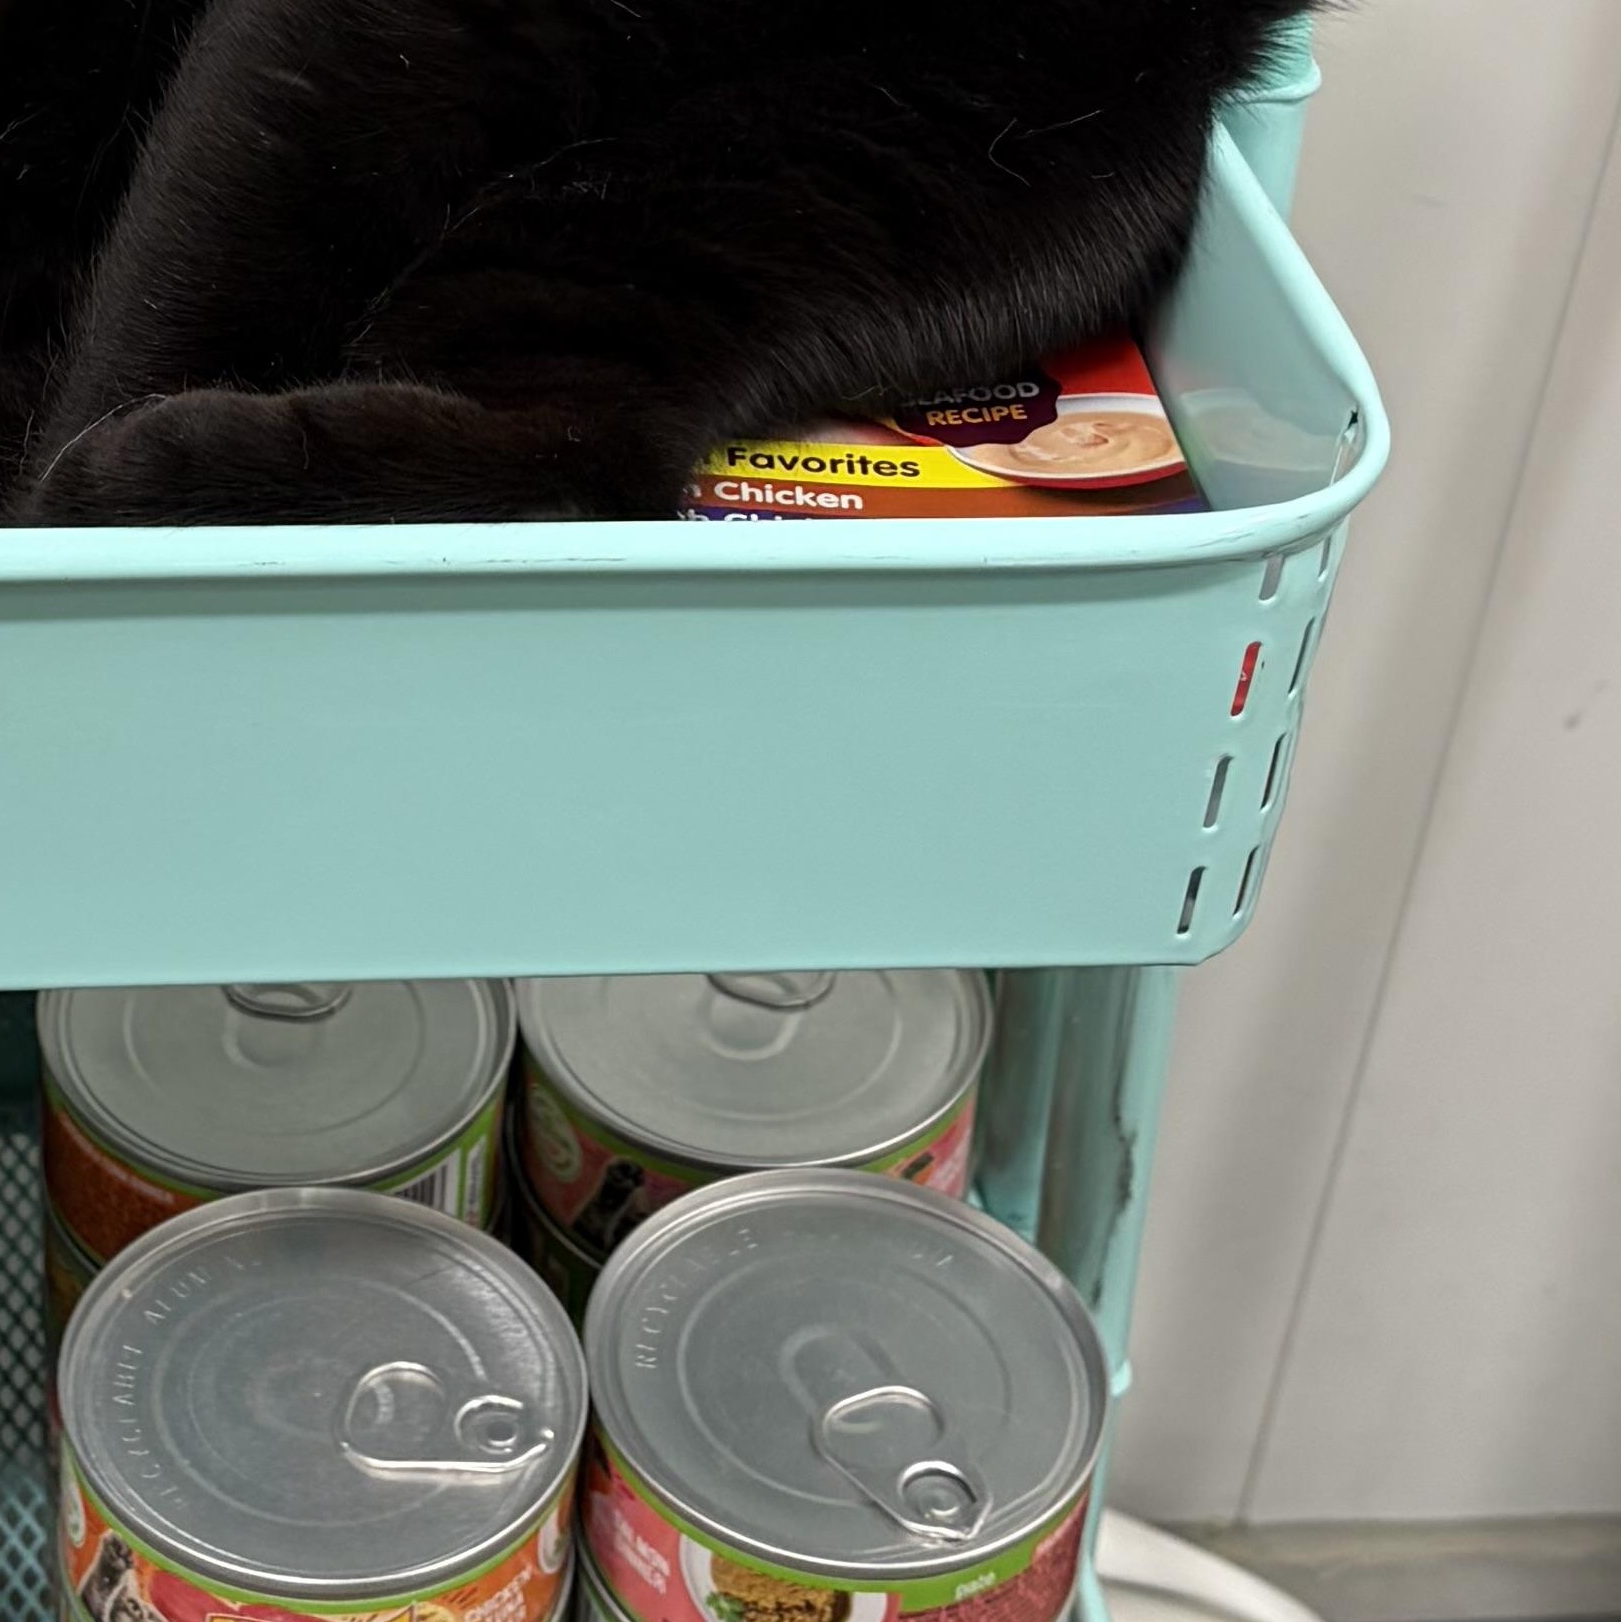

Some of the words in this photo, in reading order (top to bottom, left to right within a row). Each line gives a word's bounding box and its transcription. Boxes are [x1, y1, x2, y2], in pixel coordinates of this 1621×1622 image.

[901, 381, 1041, 407] AFOOD
[925, 403, 1029, 427] RECIPE
[727, 446, 921, 478] Favorites
[713, 481, 865, 510] Chicken
